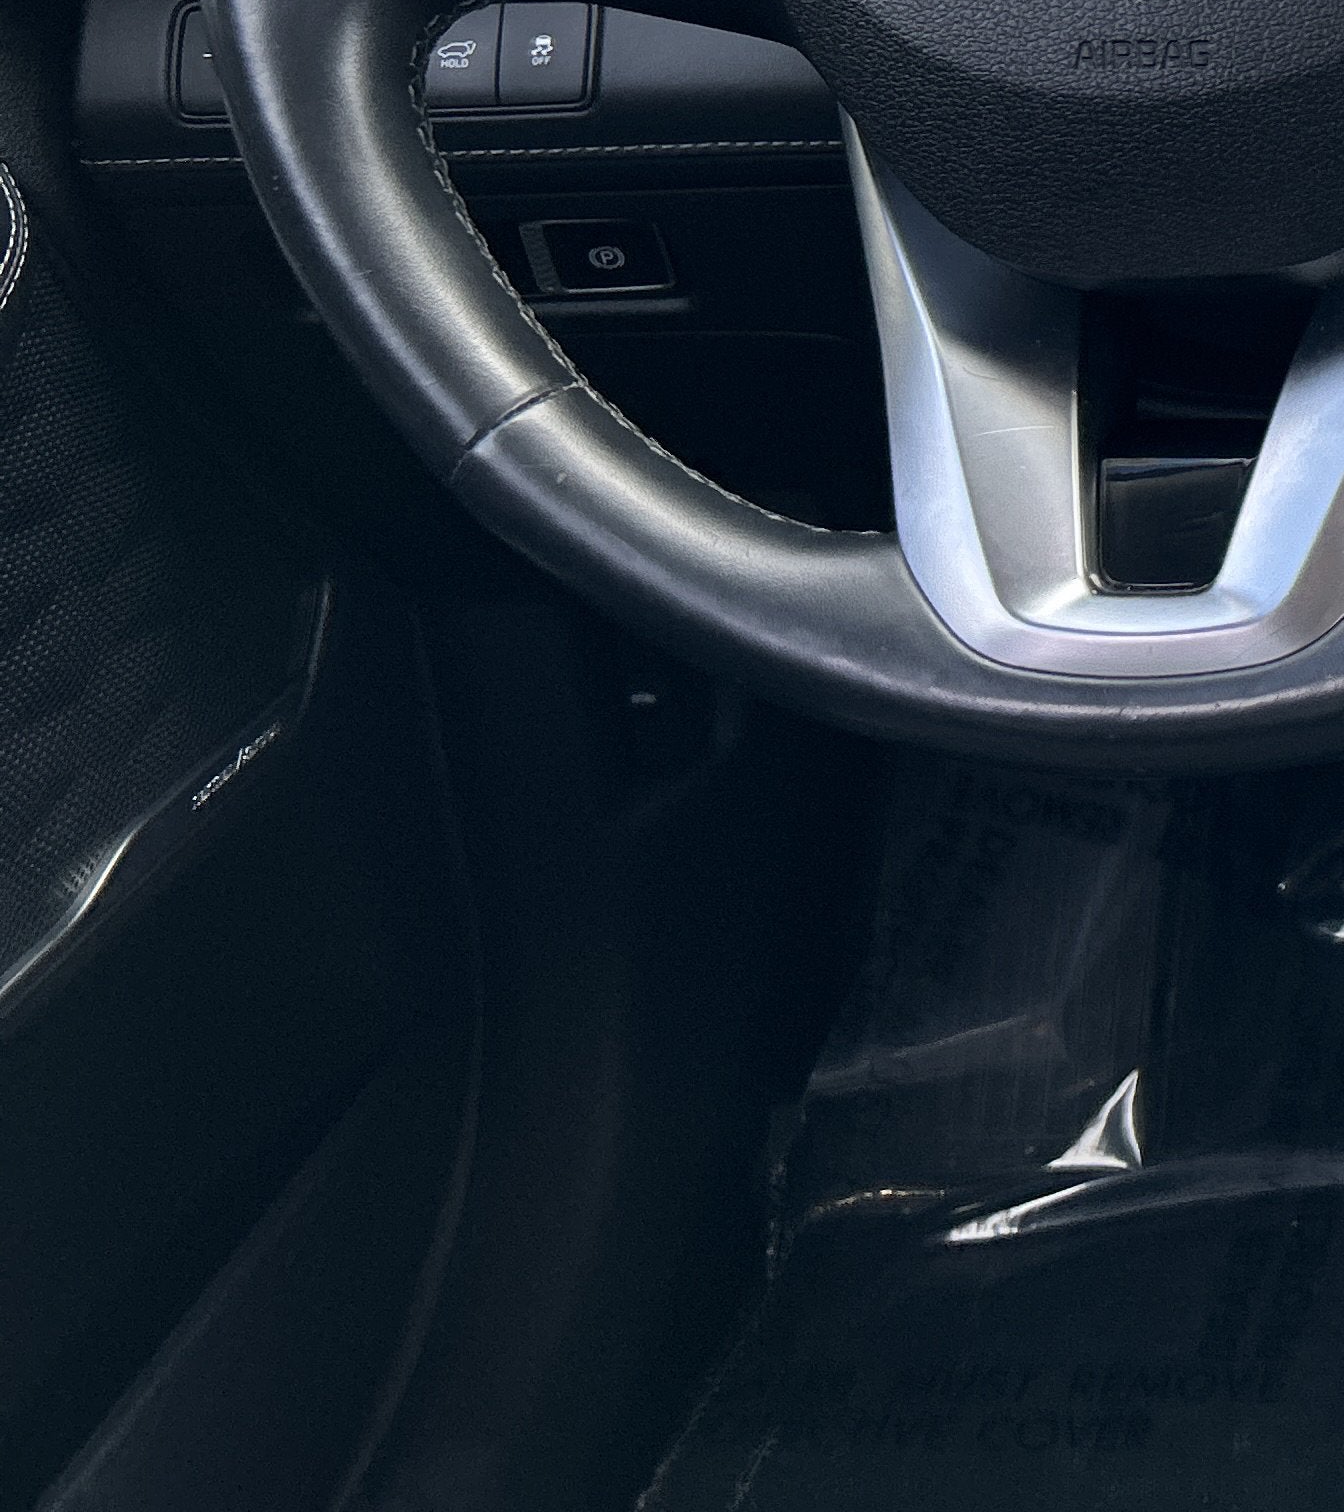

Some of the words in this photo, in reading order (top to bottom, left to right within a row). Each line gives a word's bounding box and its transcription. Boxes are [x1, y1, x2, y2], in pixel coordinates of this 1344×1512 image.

[531, 55, 551, 66] OFF
[1073, 40, 1211, 69] AIRBAG
[440, 57, 471, 69] HOLD
